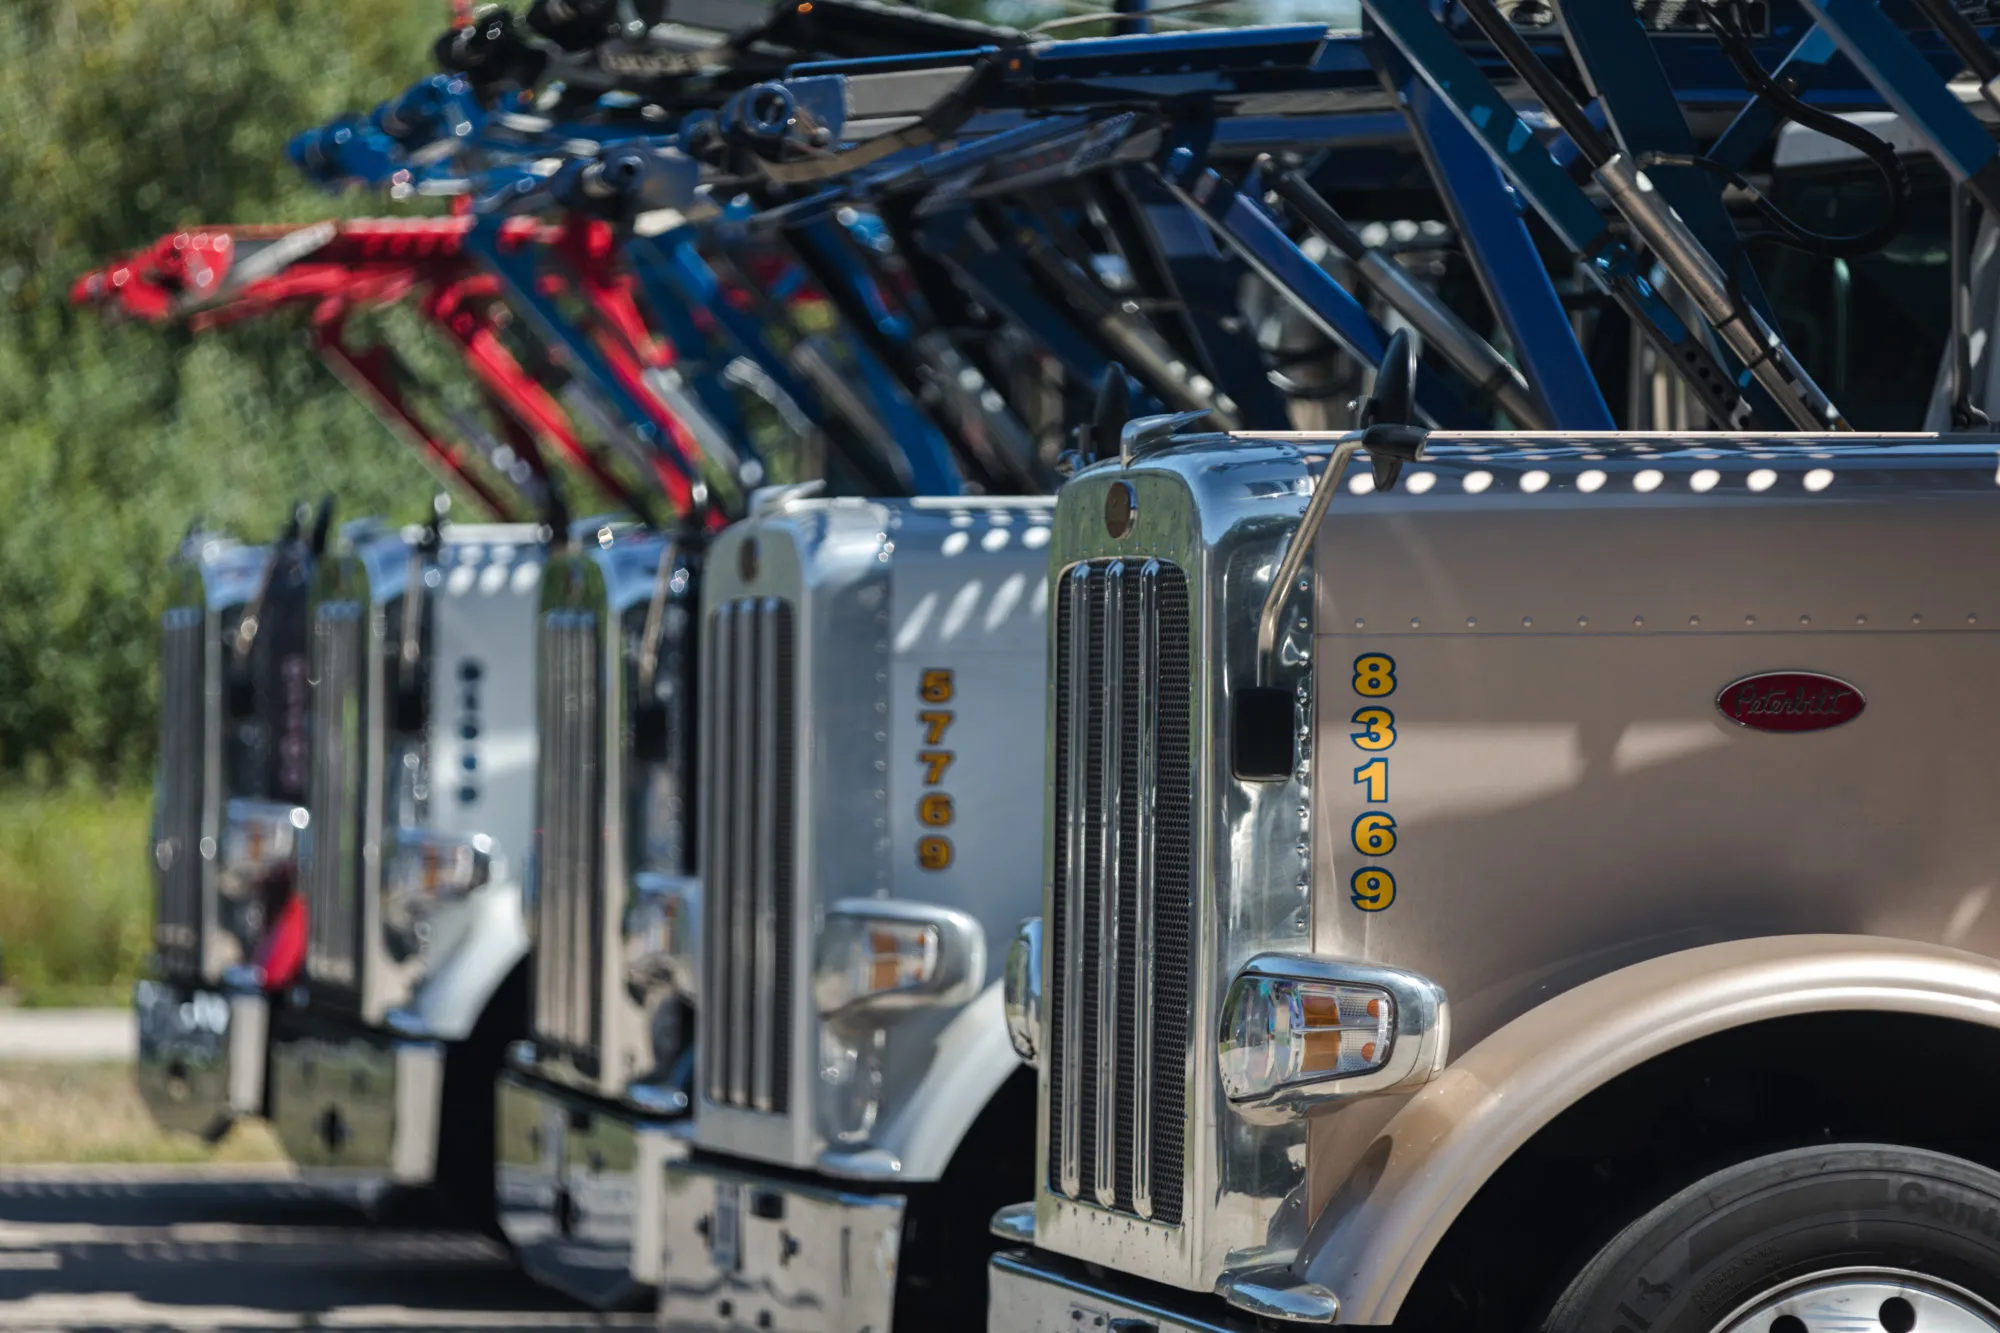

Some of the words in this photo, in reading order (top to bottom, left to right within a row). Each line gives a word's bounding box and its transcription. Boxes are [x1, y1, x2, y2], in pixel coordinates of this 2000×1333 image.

[1734, 683, 1852, 718] Peterbilt
[916, 666, 955, 874] 57769
[1350, 652, 1397, 912] 83169
[1898, 1181, 2000, 1242] Cont
